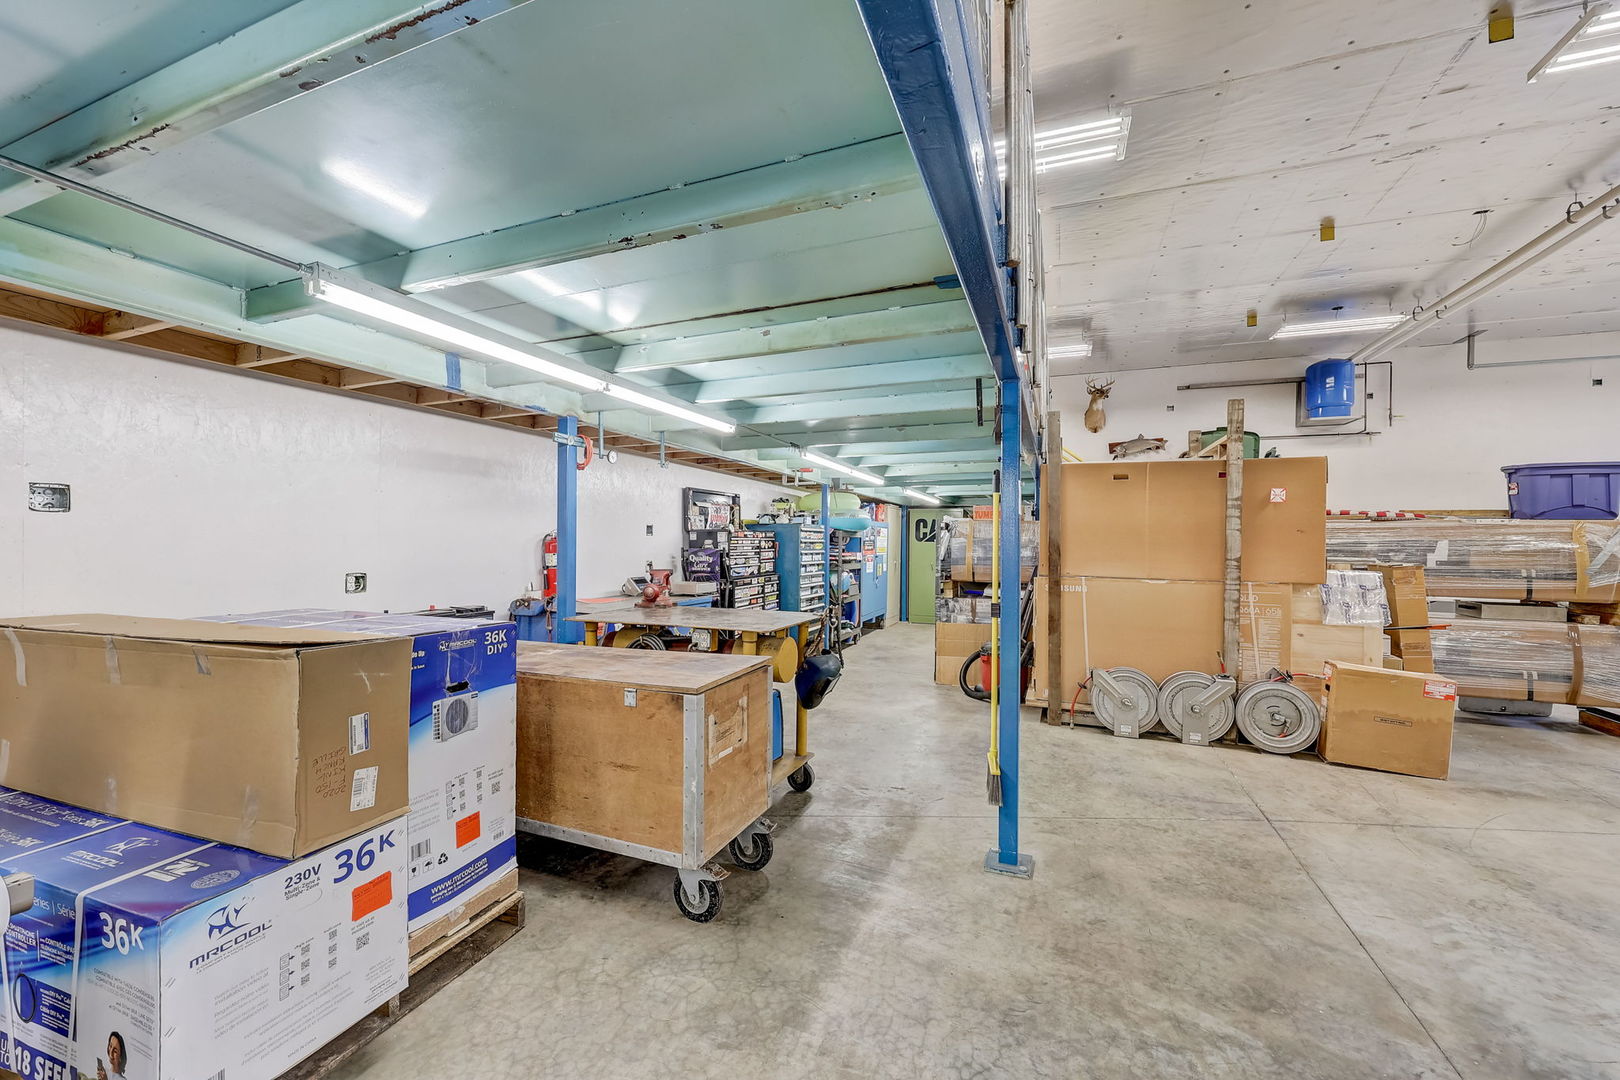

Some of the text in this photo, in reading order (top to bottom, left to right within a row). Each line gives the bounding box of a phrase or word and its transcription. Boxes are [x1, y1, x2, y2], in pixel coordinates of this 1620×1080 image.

[915, 518, 937, 543] CA
[689, 554, 713, 564] Quality
[1045, 584, 1088, 592] SSUNG
[484, 629, 507, 645] 36K
[334, 829, 396, 884] 36K
[284, 863, 321, 889] 230V
[431, 857, 488, 894] www.mrcool.com
[33, 896, 50, 911] eries
[99, 911, 144, 956] 36K
[189, 922, 273, 969] MRCOOL
[15, 1046, 31, 1075] 18
